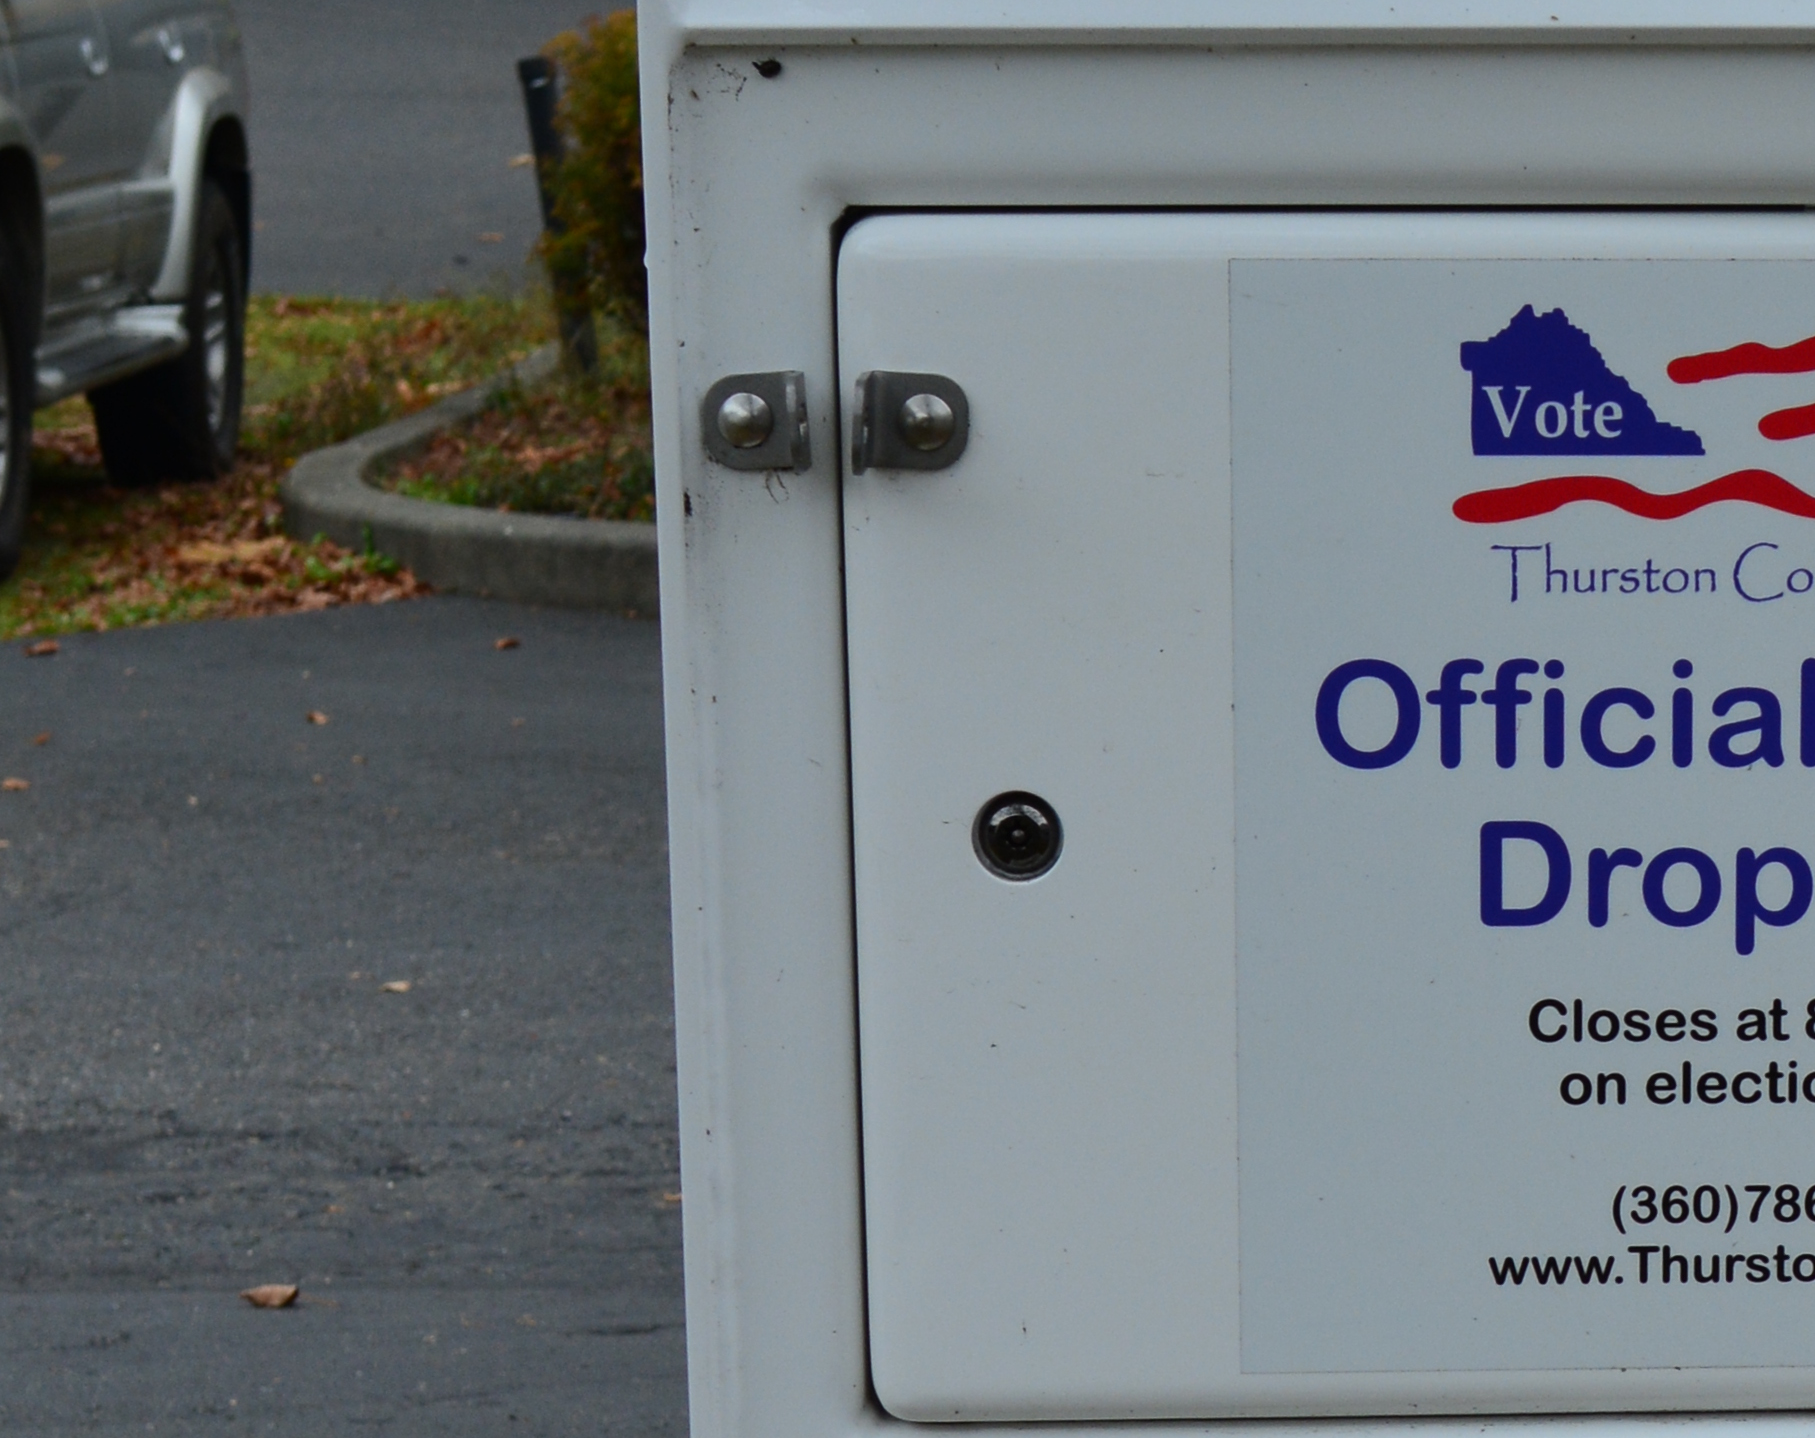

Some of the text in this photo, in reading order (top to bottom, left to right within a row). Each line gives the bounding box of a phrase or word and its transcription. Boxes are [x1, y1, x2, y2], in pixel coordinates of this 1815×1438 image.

[1481, 385, 1623, 438] Vote
[1490, 542, 1716, 603] Thurston
[1480, 821, 1813, 955] Drop
[1529, 999, 1718, 1044] Closes
[1736, 998, 1790, 1042] at
[1560, 1073, 1626, 1105] on
